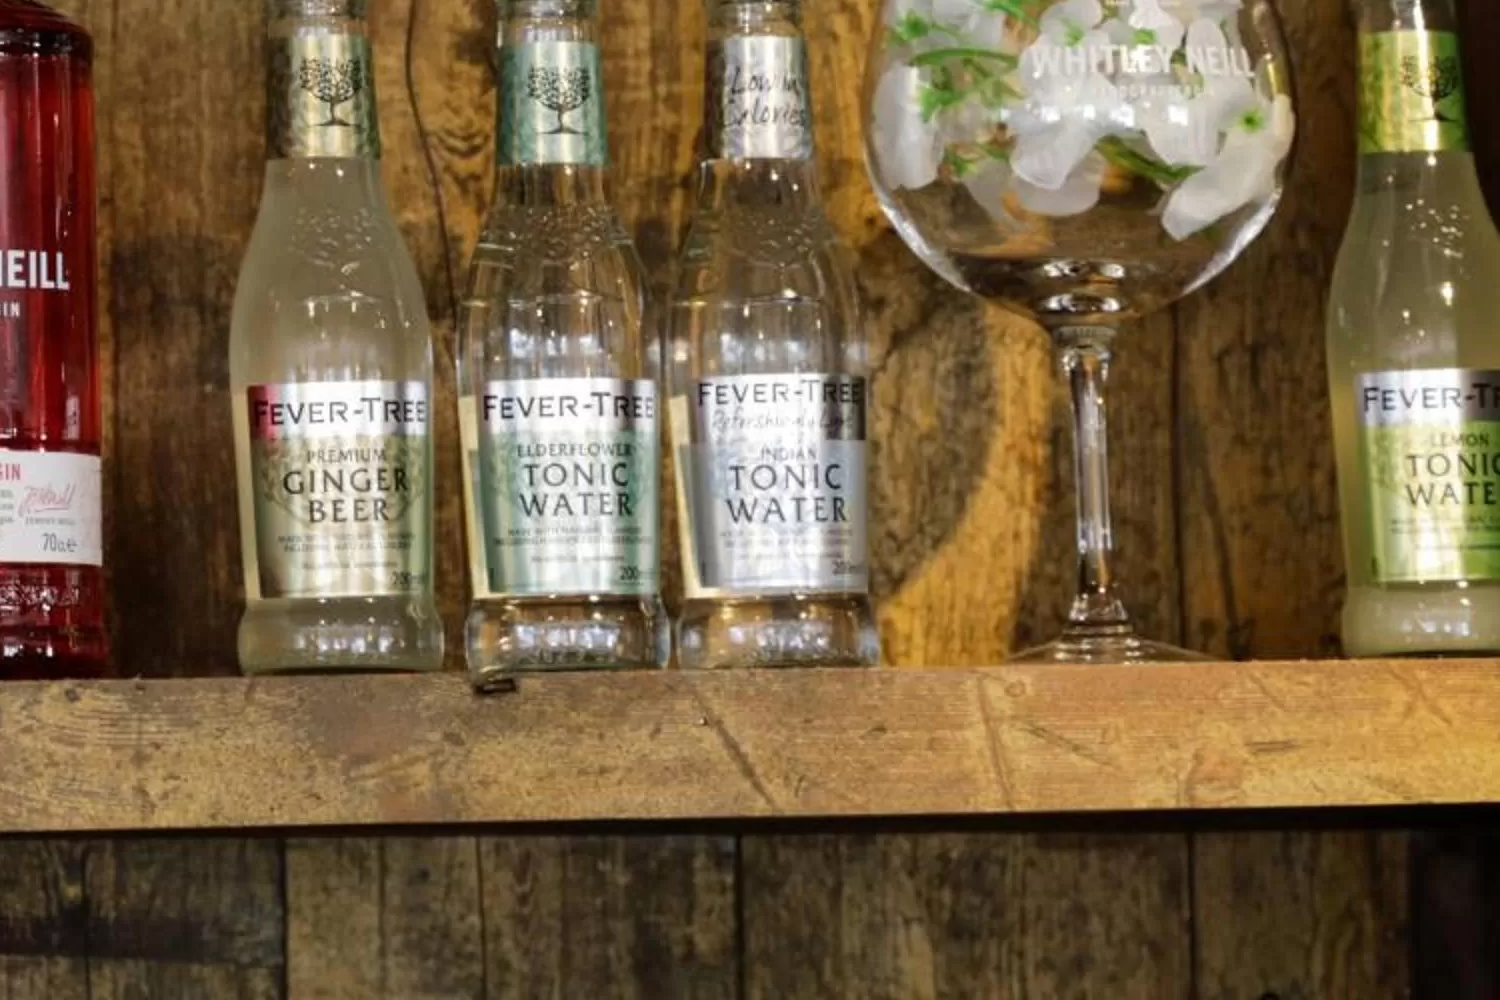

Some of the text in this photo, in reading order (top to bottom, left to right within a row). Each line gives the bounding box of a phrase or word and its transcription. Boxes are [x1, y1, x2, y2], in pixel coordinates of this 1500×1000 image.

[1031, 43, 1256, 78] WHITLEY NEILL
[698, 379, 864, 406] FEVER-TREE
[252, 396, 427, 429] FEVER-TREE
[483, 391, 654, 421] FEVER-TREE
[516, 442, 634, 459] ELDERFLOWER
[1430, 432, 1490, 448] LEMON
[306, 448, 387, 464] PREMIUM
[760, 447, 818, 462] INDIAN
[282, 467, 410, 496] GINGER
[523, 462, 629, 488] TONIC
[728, 463, 842, 491] TONIC
[308, 498, 390, 523] BEER
[519, 492, 633, 518] WATER
[724, 496, 848, 524] WATER
